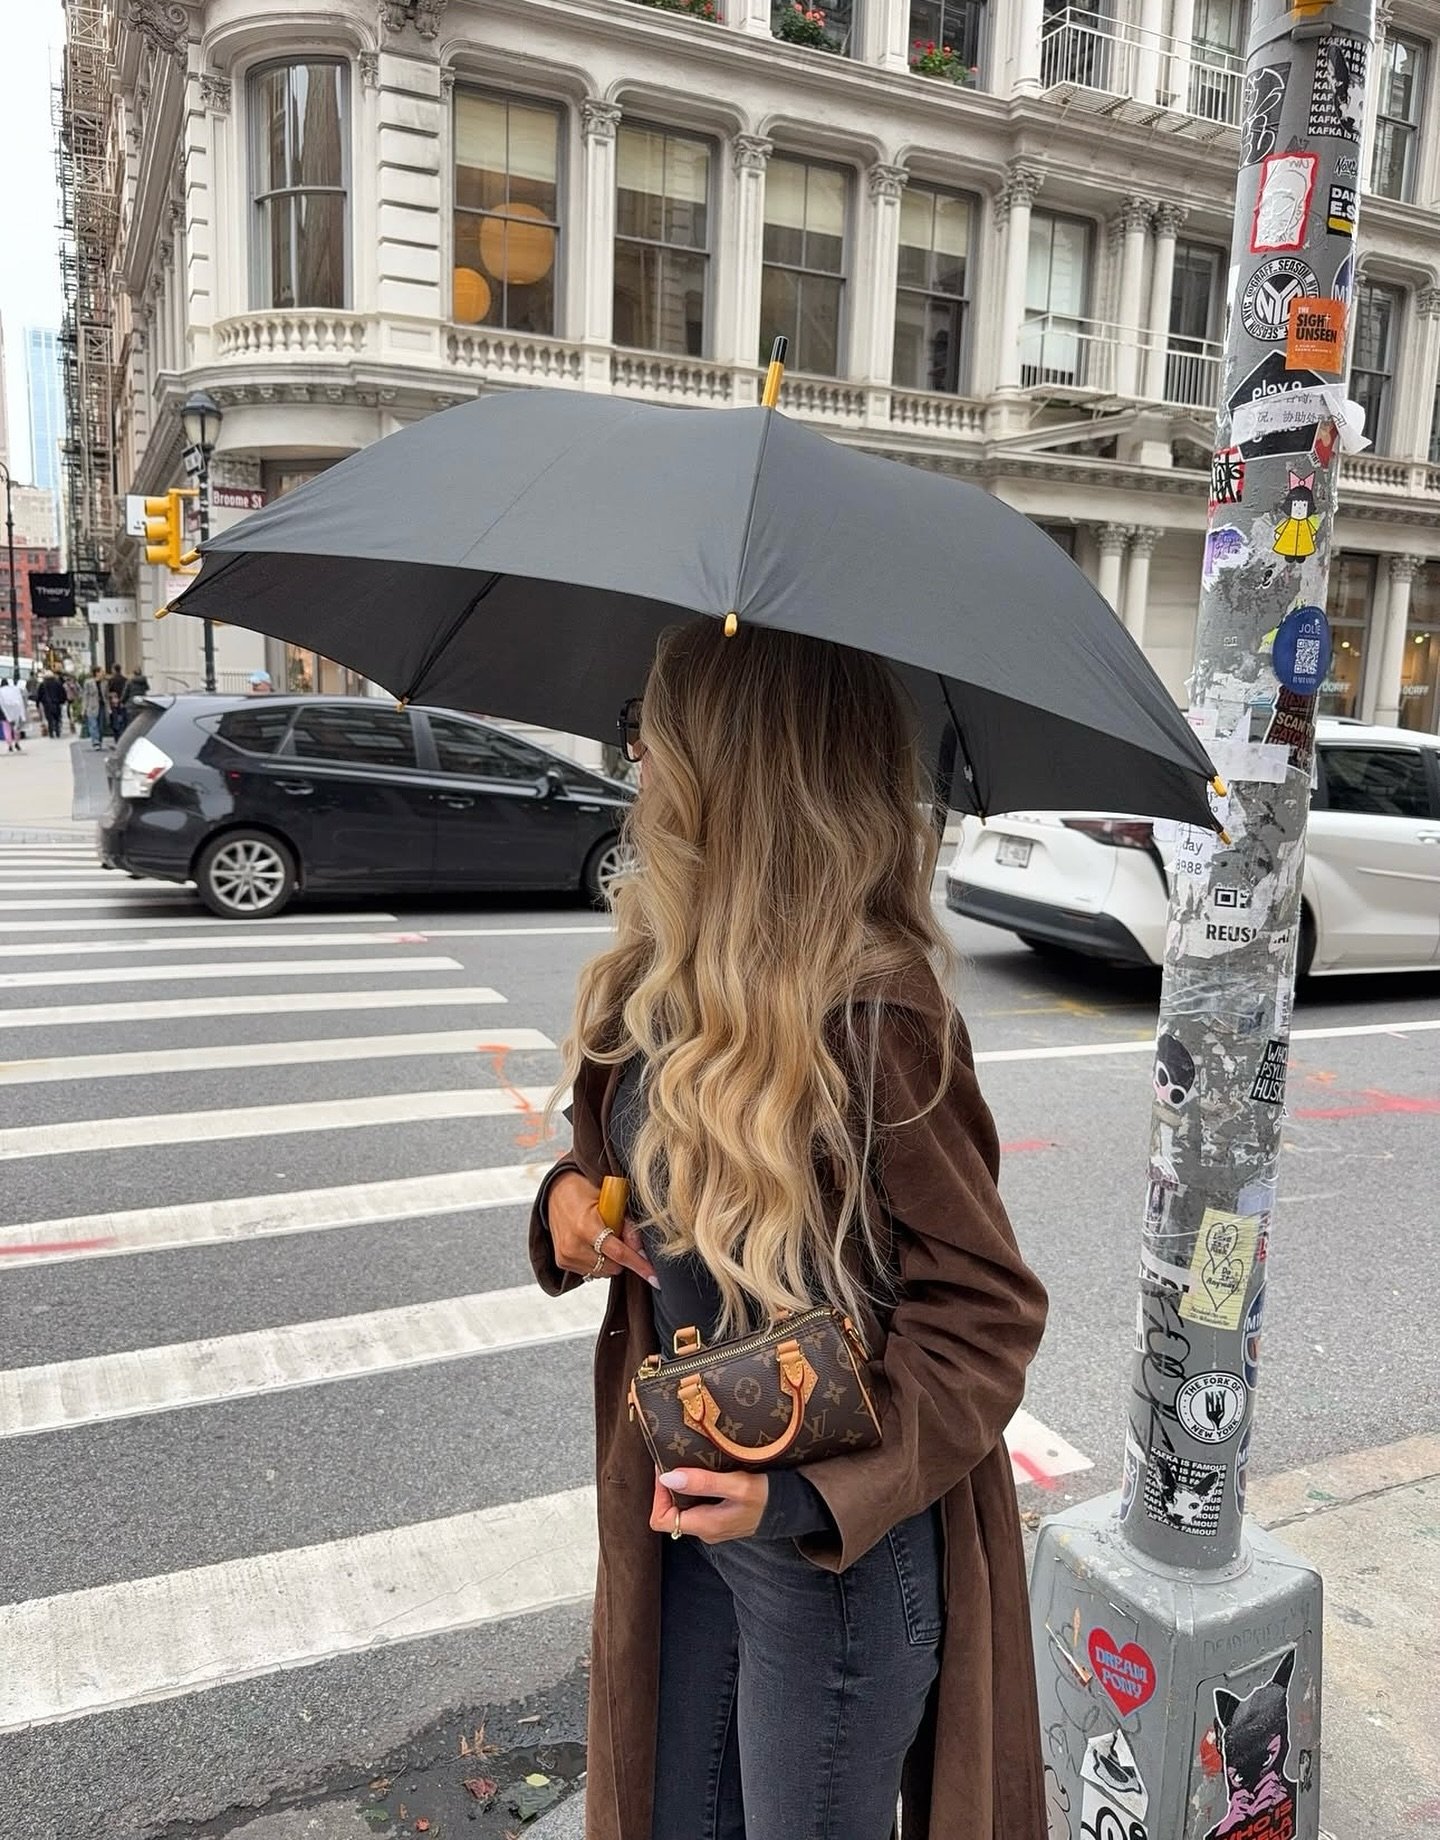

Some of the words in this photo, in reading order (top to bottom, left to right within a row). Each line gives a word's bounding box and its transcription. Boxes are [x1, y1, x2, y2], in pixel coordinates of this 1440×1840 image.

[1308, 125, 1342, 137] KAFKA
[1296, 327, 1337, 344] UNSEEN
[213, 491, 249, 506] Broome
[252, 494, 262, 508] St
[35, 586, 71, 597] Theory
[1276, 711, 1306, 733] SCAN
[1185, 1382, 1202, 1398] THE
[1203, 1377, 1230, 1385] FORK
[1231, 1382, 1241, 1391] OF
[1191, 1424, 1213, 1438] NEW
[1216, 1419, 1240, 1437] YORK
[1179, 1467, 1189, 1475] IS
[1192, 1462, 1227, 1471] FAMOUS
[1178, 1475, 1187, 1483] IS
[1181, 1526, 1217, 1535] FAMOUS
[1095, 1645, 1148, 1684] DREAM
[1102, 1667, 1142, 1699] PONY
[1275, 1799, 1293, 1820] IS
